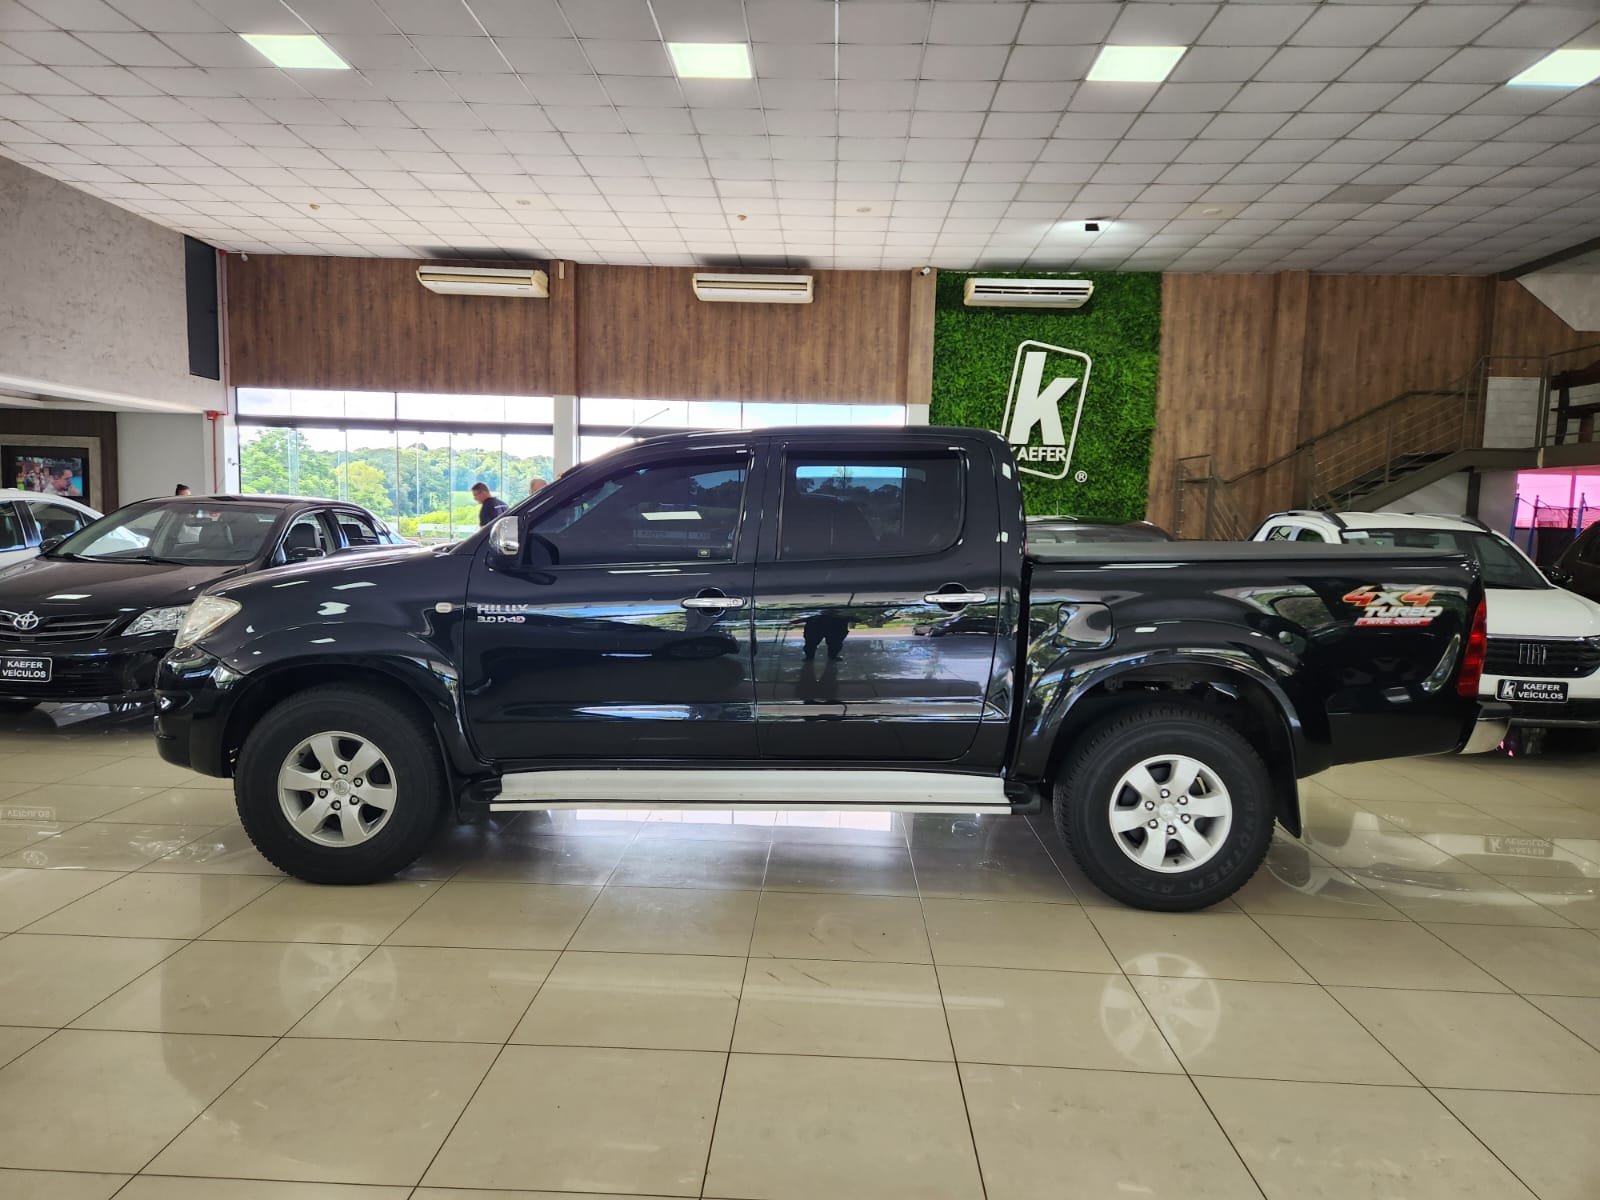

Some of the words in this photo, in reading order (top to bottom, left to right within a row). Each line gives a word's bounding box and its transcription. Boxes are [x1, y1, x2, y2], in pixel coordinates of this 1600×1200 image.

[1008, 351, 1079, 446] K
[1010, 446, 1067, 462] AEFER
[476, 603, 529, 614] HILUX
[1363, 606, 1444, 618] TURBO
[1518, 643, 1549, 665] FIAT
[6, 660, 43, 669] KAEFER
[1523, 683, 1560, 691] KAEFER
